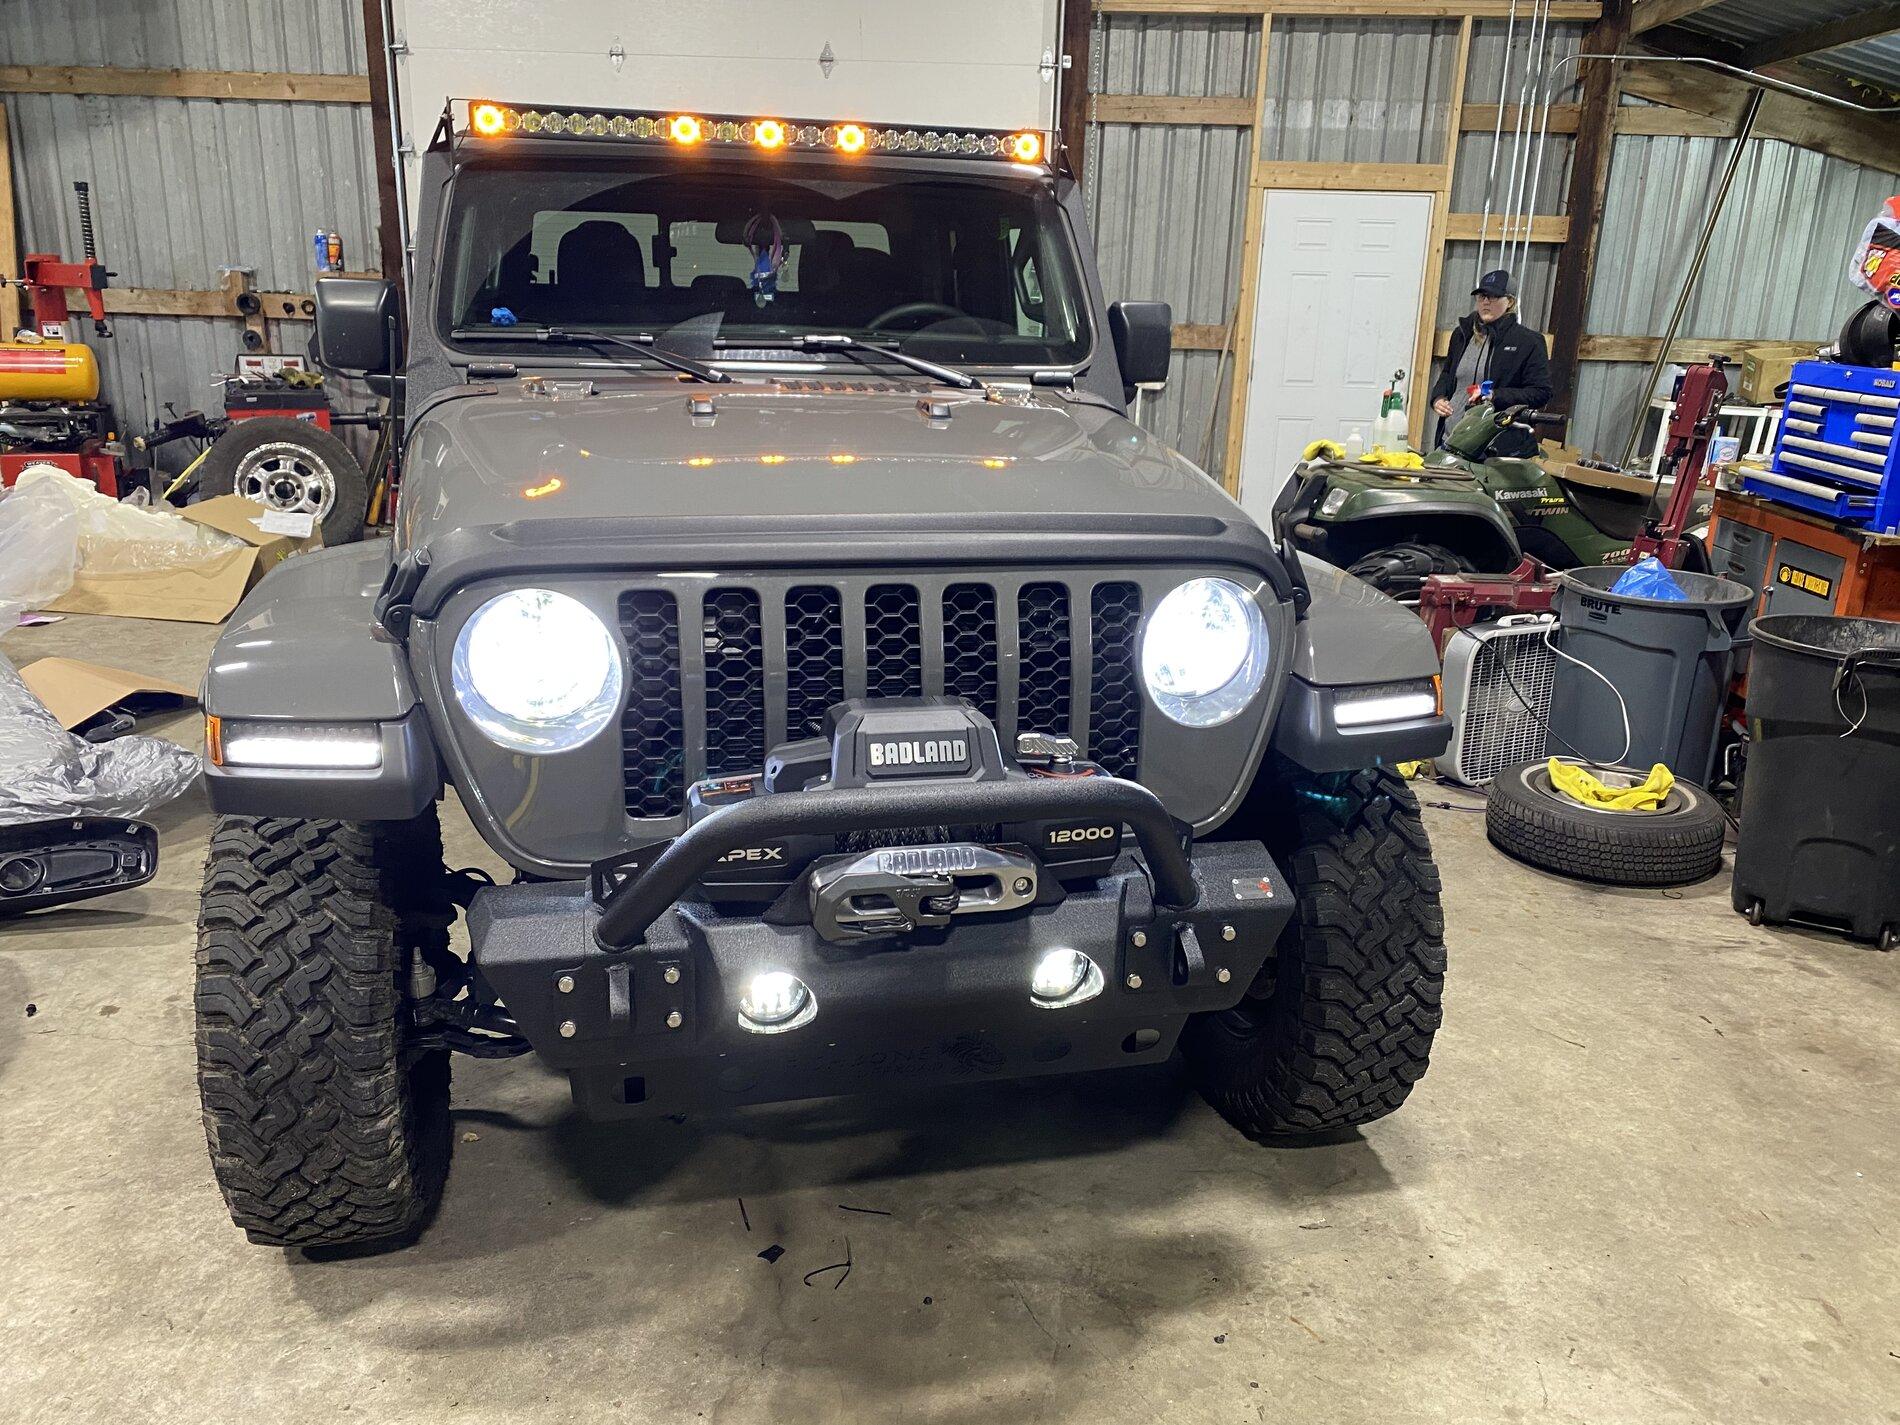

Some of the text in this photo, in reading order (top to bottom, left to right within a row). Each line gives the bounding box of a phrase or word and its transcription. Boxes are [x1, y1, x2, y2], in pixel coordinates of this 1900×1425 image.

[1494, 487, 1548, 501] Kawasaki
[1600, 548, 1631, 560] 700
[1581, 596, 1622, 615] BRUTE
[869, 739, 967, 766] BADLAND
[1049, 826, 1115, 843] 12000
[878, 847, 977, 874] BADLAND
